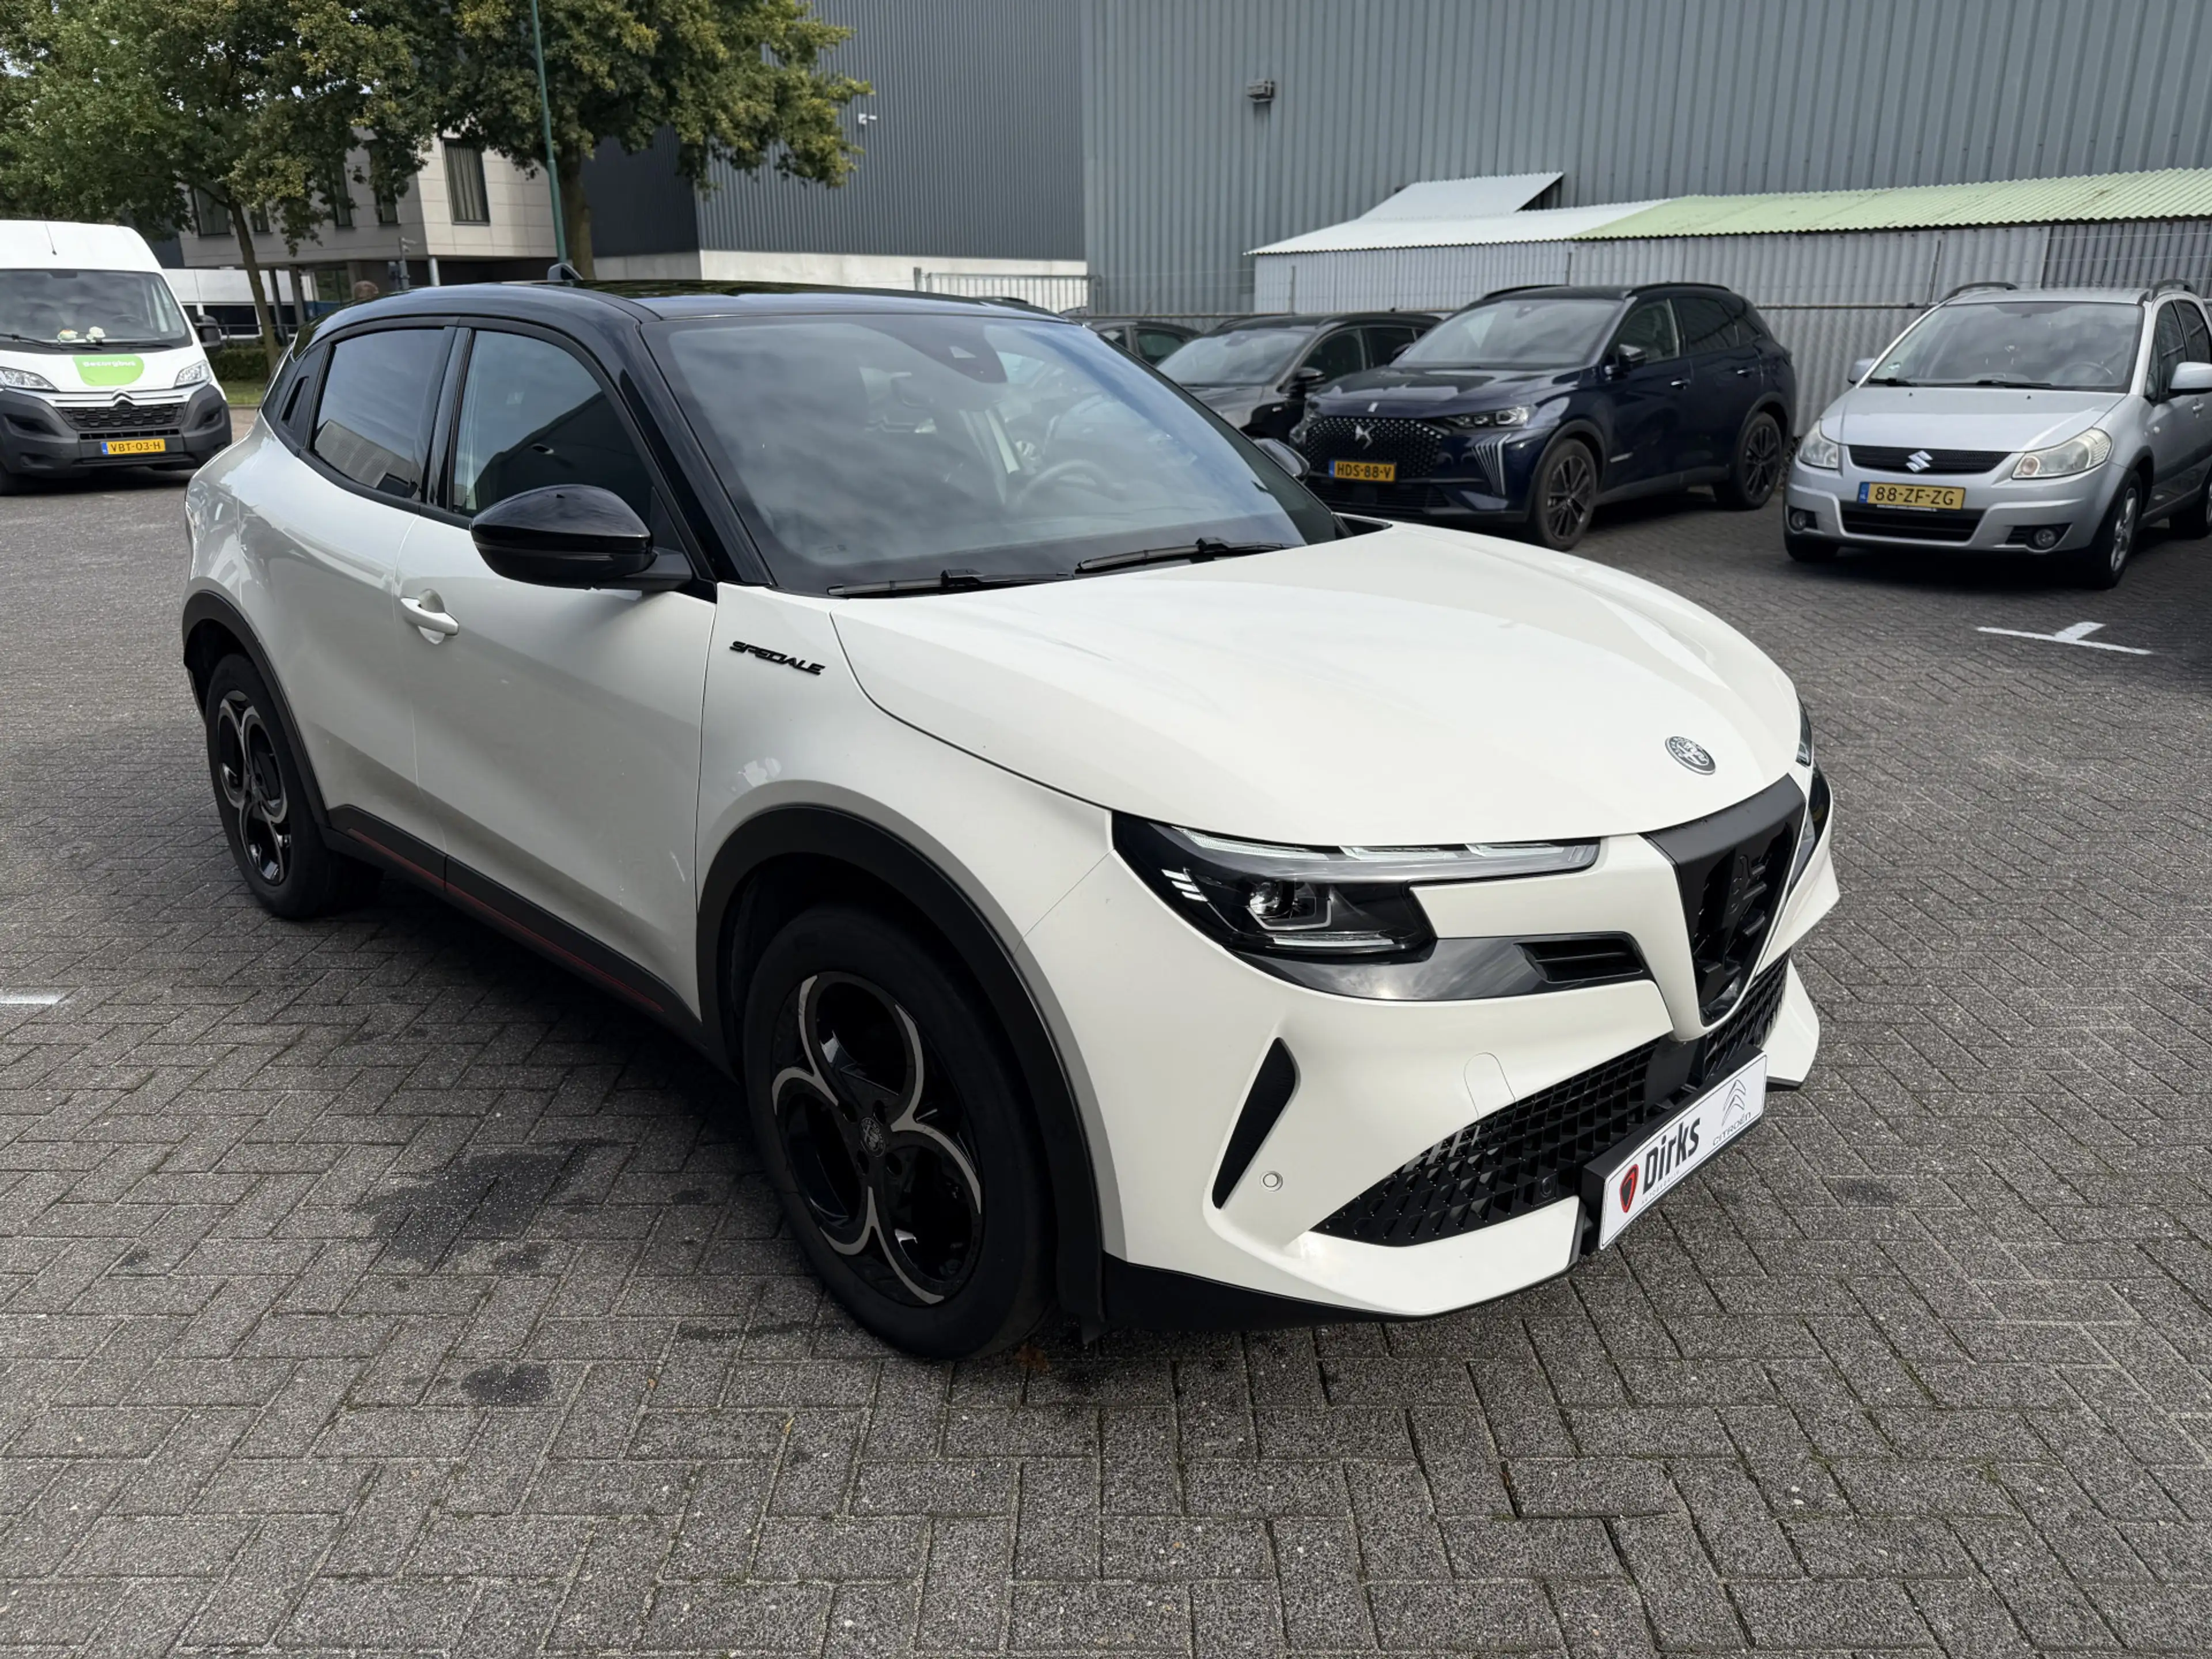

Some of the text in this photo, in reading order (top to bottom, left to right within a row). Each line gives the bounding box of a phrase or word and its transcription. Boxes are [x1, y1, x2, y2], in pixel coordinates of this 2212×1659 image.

[110, 441, 161, 452] VBT-03-H
[1337, 463, 1392, 479] HDS-88-V
[1875, 486, 1955, 505] 88-ZF-ZG
[1642, 1117, 1700, 1195] Dirks
